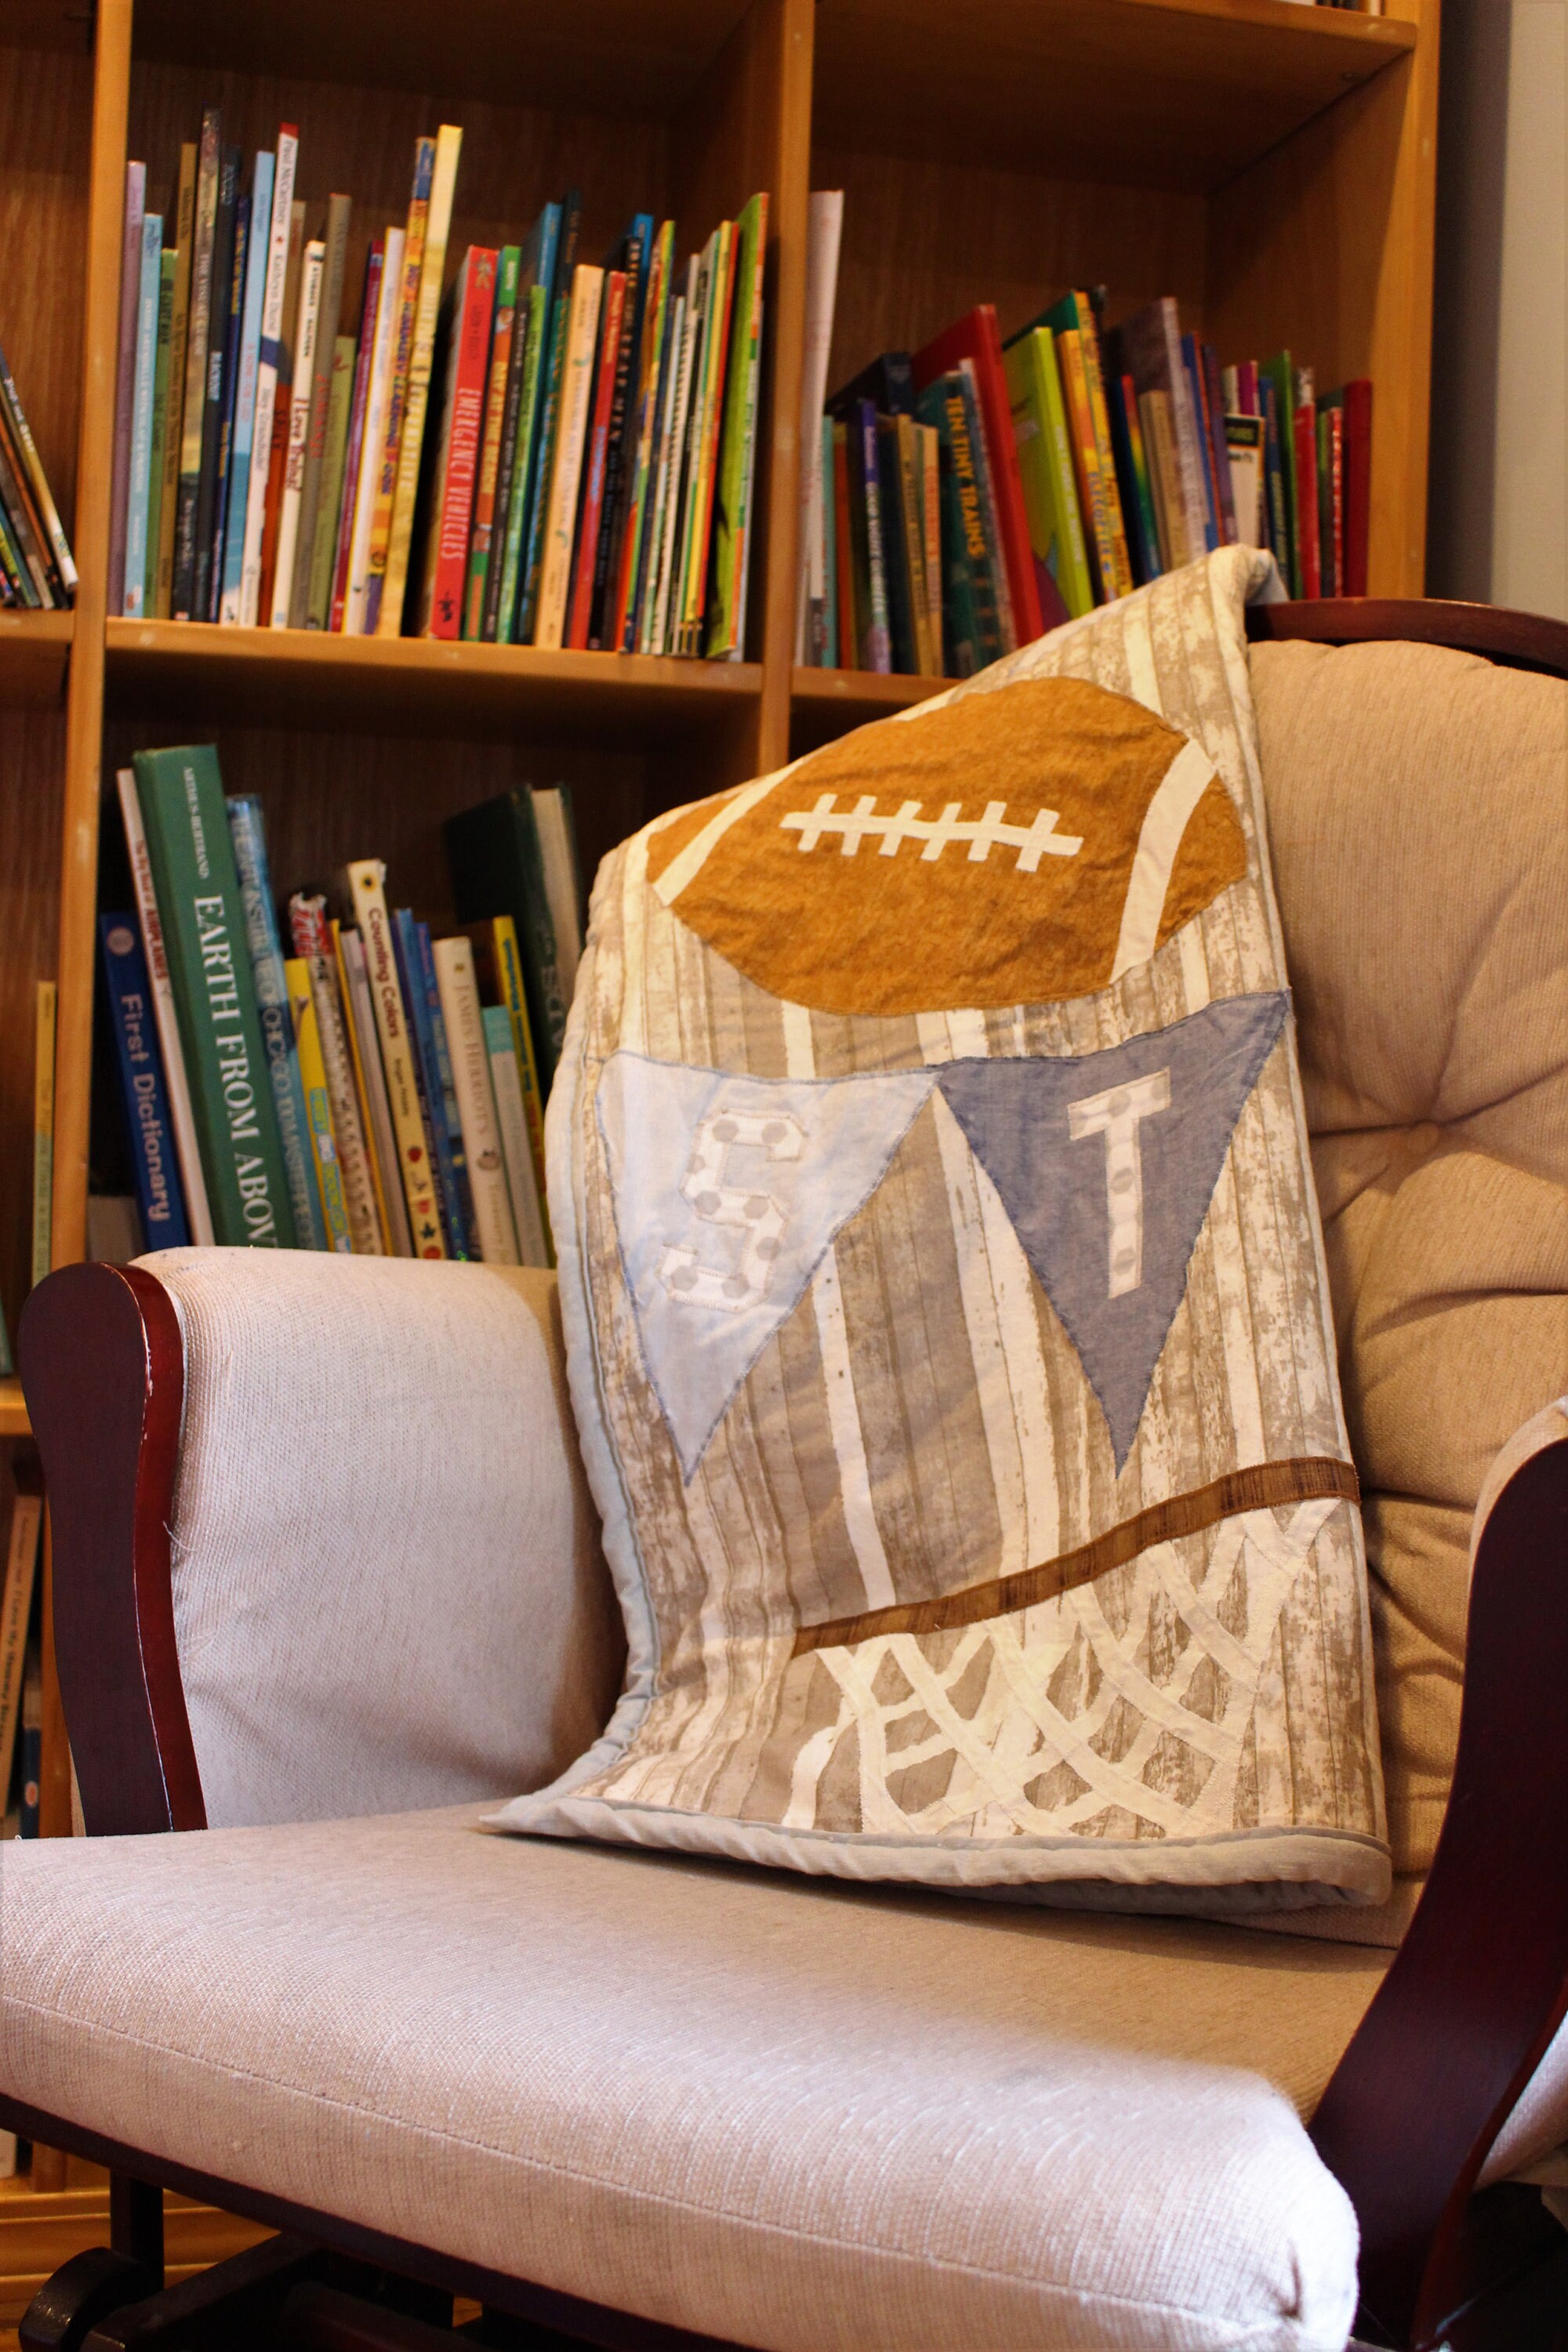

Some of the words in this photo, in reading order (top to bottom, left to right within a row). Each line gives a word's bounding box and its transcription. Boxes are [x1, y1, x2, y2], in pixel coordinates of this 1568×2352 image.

[452, 387, 482, 481] EMERGENCY
[946, 396, 966, 431] TEN
[953, 435, 975, 479] TINY
[441, 485, 471, 560] VEHICLES
[960, 485, 985, 557] TRAINS
[145, 907, 169, 982] AIRPLANES
[194, 894, 241, 1021] EARTH
[368, 907, 392, 983] Counting
[381, 986, 401, 1039] Colors
[119, 993, 150, 1063] First
[216, 1033, 261, 1141] FROM
[132, 1073, 171, 1221] Dictionary
[656, 1106, 809, 1313] S
[1067, 1066, 1171, 1300] T
[234, 1152, 278, 1249] ABOV
